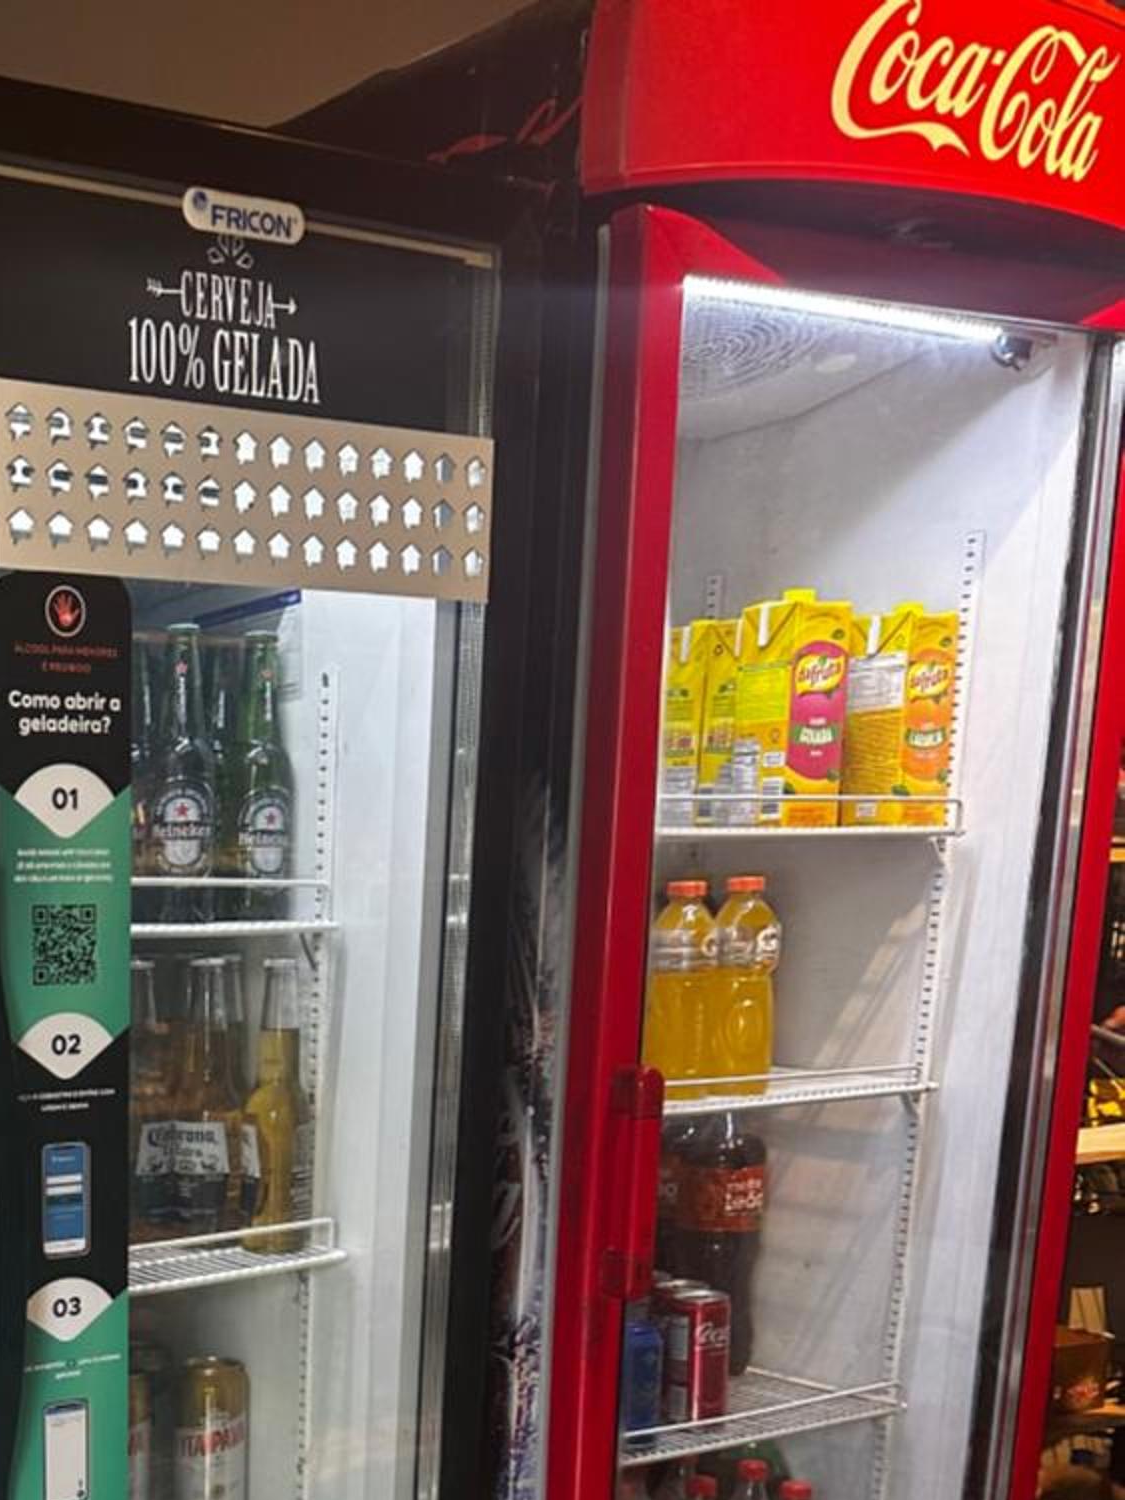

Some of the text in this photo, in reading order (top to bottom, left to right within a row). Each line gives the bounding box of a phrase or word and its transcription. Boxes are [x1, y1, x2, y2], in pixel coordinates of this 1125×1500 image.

[831, 0, 1120, 181] Coca-Cola
[211, 204, 292, 238] FRICON
[180, 269, 276, 330] CERVEJA
[128, 316, 321, 404] 100% GELADA
[8, 689, 122, 712] Como abrir a
[18, 713, 112, 736] geladeira?
[52, 786, 78, 811] 01
[51, 1033, 82, 1056] 02
[52, 1296, 82, 1318] 03
